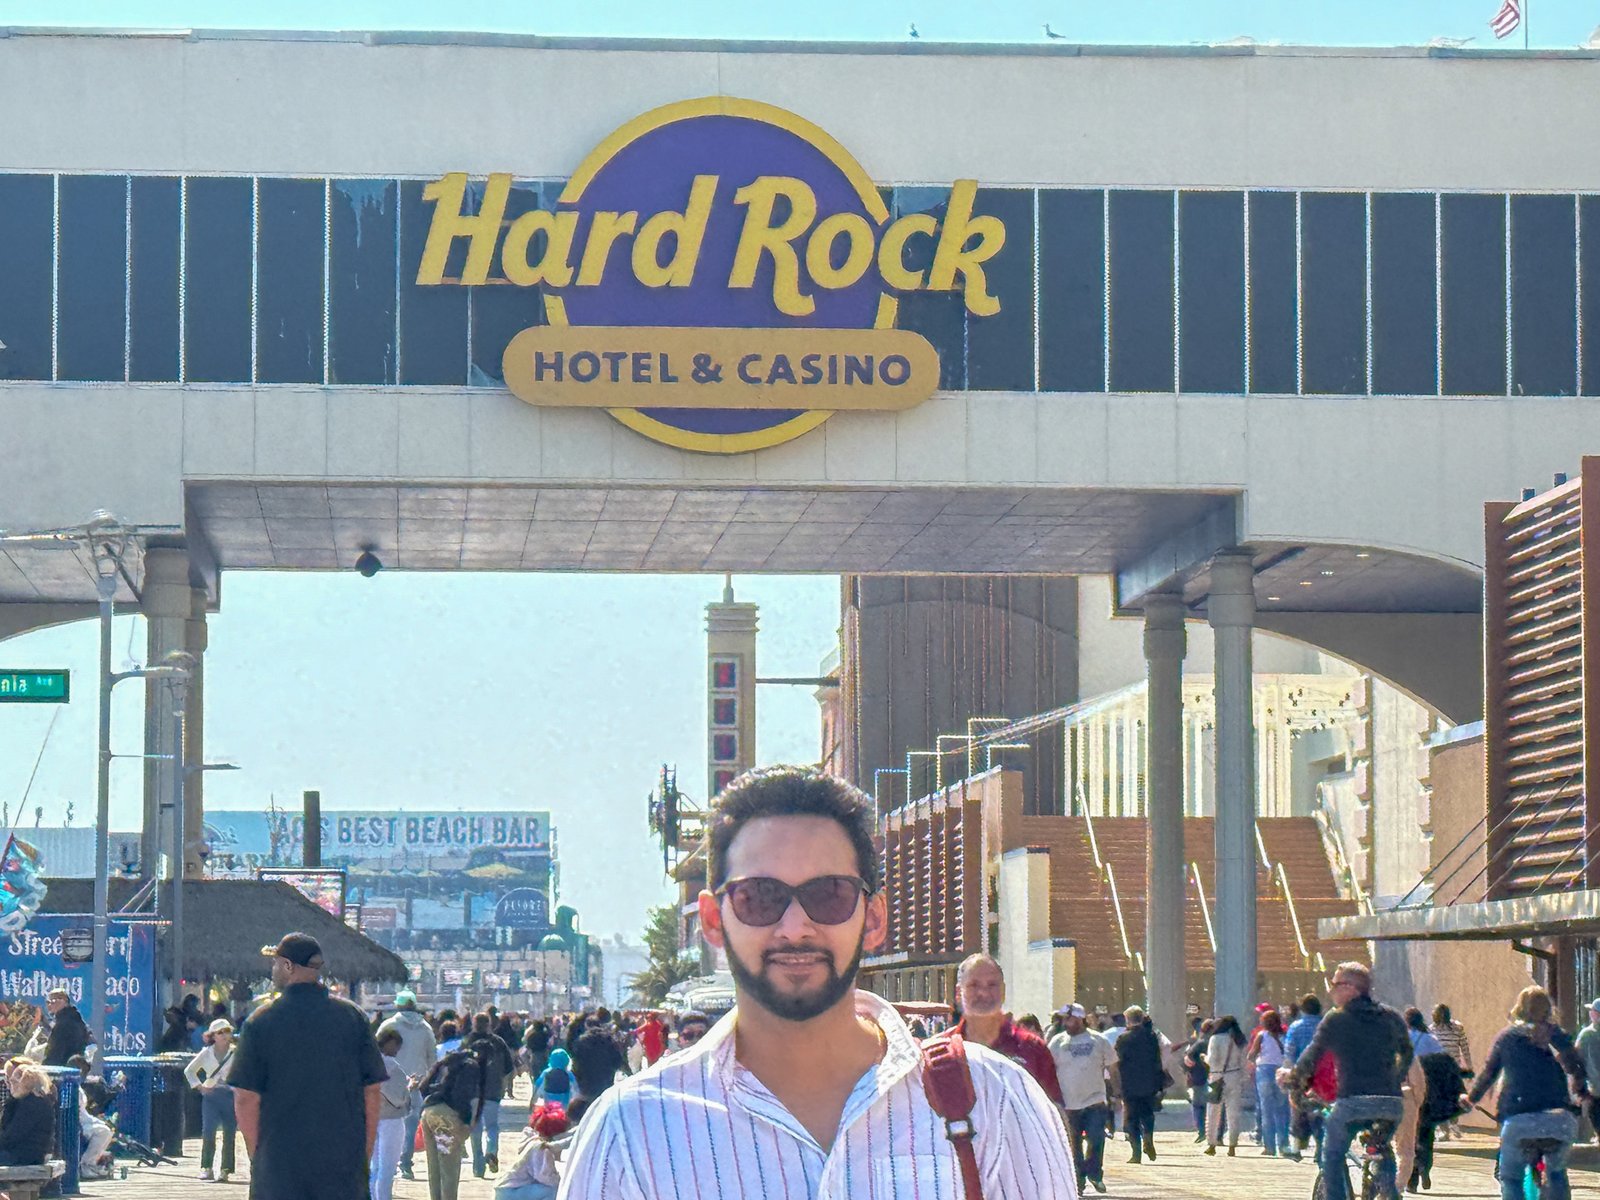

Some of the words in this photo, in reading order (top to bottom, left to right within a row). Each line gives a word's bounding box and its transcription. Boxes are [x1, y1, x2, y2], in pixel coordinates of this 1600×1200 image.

[416, 172, 720, 287] Hard
[728, 179, 1006, 317] Rock
[534, 351, 678, 384] HOTEL
[691, 355, 722, 383] &
[737, 353, 911, 386] CASINO
[338, 816, 397, 845] BEST
[406, 816, 483, 845] BEACH
[493, 816, 539, 846] BAR
[105, 968, 140, 997] aco
